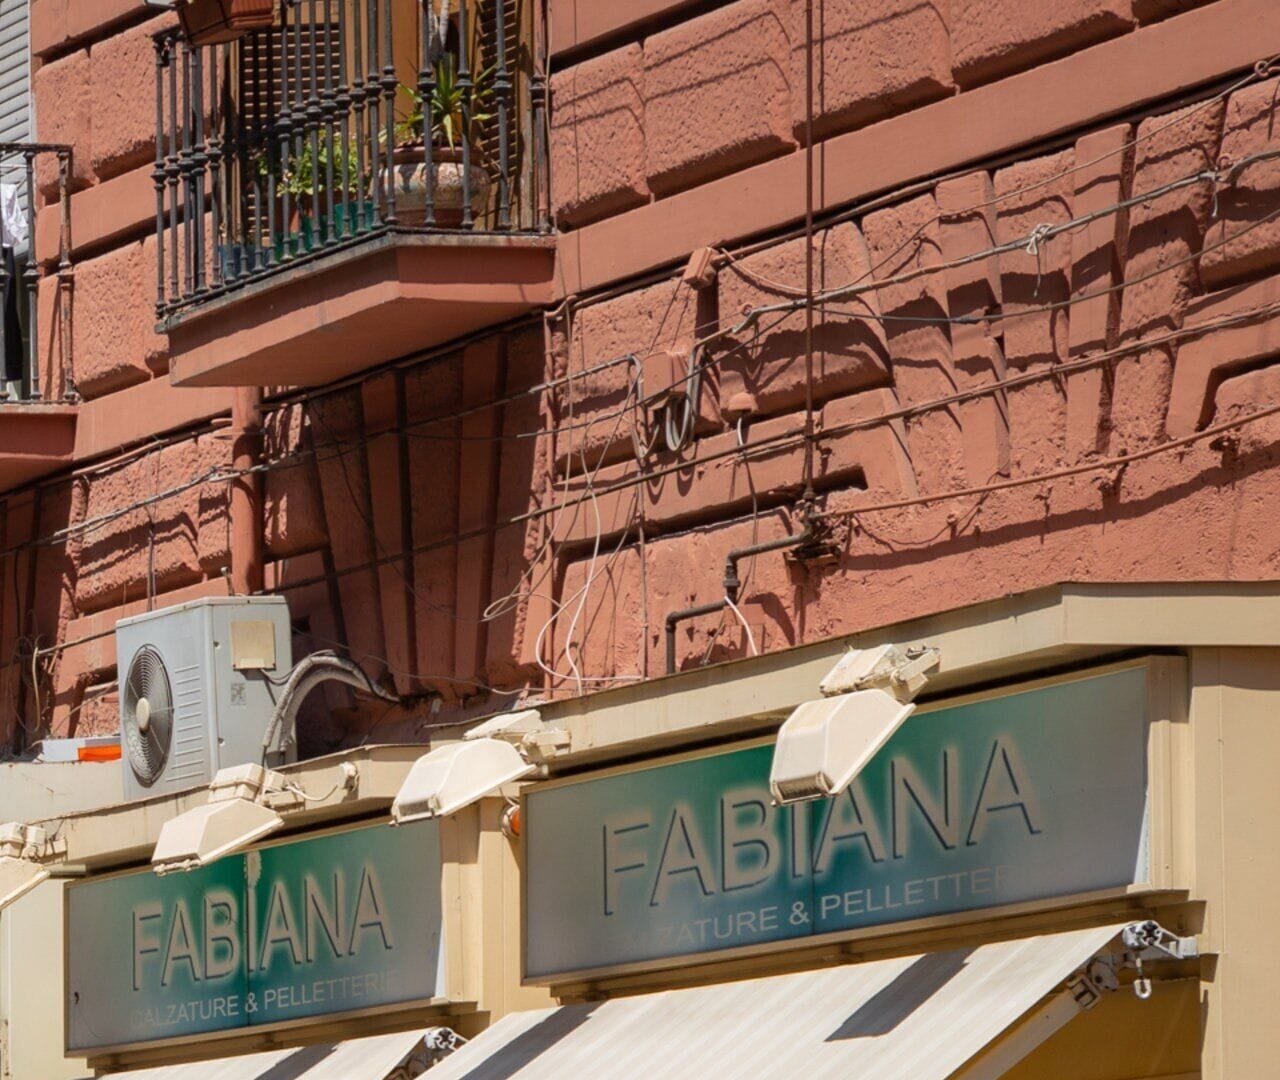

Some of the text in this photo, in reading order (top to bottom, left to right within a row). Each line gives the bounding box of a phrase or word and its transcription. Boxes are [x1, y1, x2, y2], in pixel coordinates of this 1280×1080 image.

[602, 734, 1042, 916] FABIANA
[132, 864, 393, 991] FABIANA
[628, 864, 1017, 949] ZATURE & PELLETTER
[244, 992, 258, 1011] &
